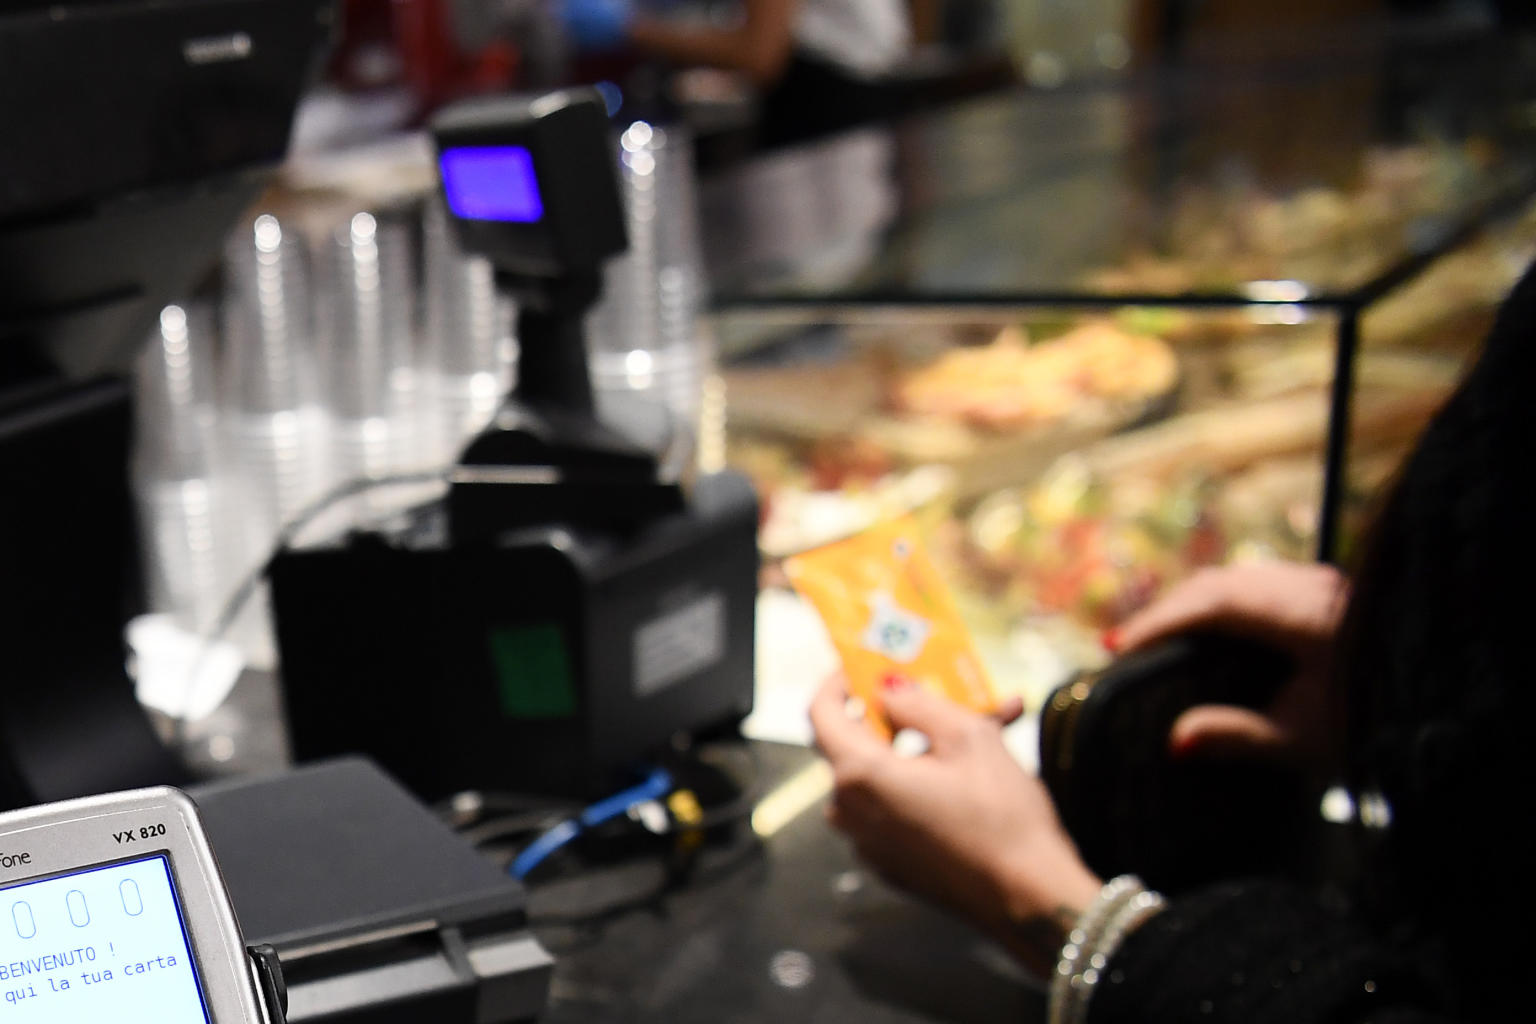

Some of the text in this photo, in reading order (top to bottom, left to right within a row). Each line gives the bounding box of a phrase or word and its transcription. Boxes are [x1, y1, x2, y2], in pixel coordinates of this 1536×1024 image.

[113, 824, 166, 844] VX 820
[5, 982, 38, 1005] qui
[48, 977, 70, 993] la
[81, 969, 113, 986] tua
[124, 955, 177, 976] carta
